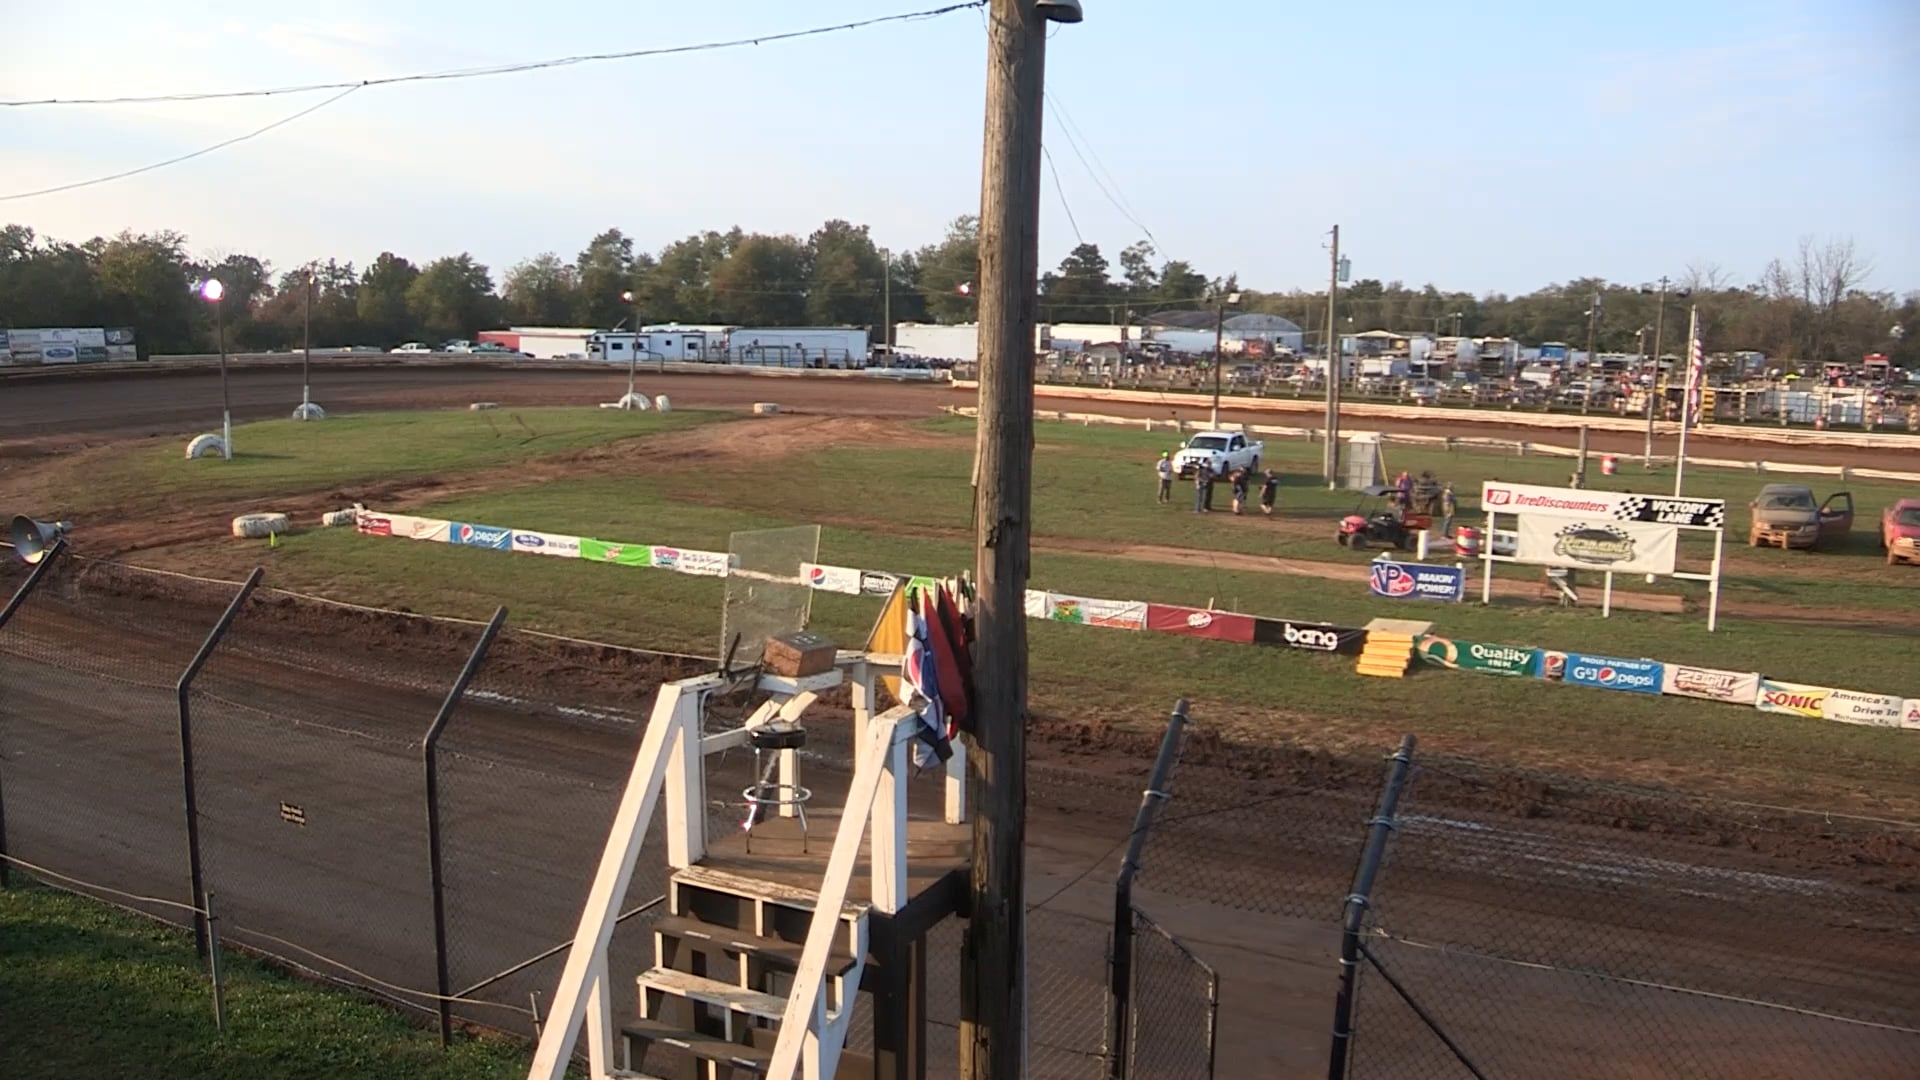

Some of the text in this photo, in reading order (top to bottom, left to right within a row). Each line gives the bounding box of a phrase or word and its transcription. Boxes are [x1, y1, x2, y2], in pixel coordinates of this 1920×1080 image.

[1515, 494, 1608, 512] TireDiscounters
[1651, 500, 1709, 514] VICTORY
[1656, 512, 1694, 524] LANE
[1373, 564, 1403, 593] VP
[1284, 622, 1338, 651] bang
[1470, 644, 1532, 665] Quality
[1617, 674, 1655, 687] pepsi
[1764, 691, 1824, 711] SONIC
[1831, 691, 1891, 705] America's
[1852, 705, 1884, 716] Drive
[1885, 709, 1900, 717] In
